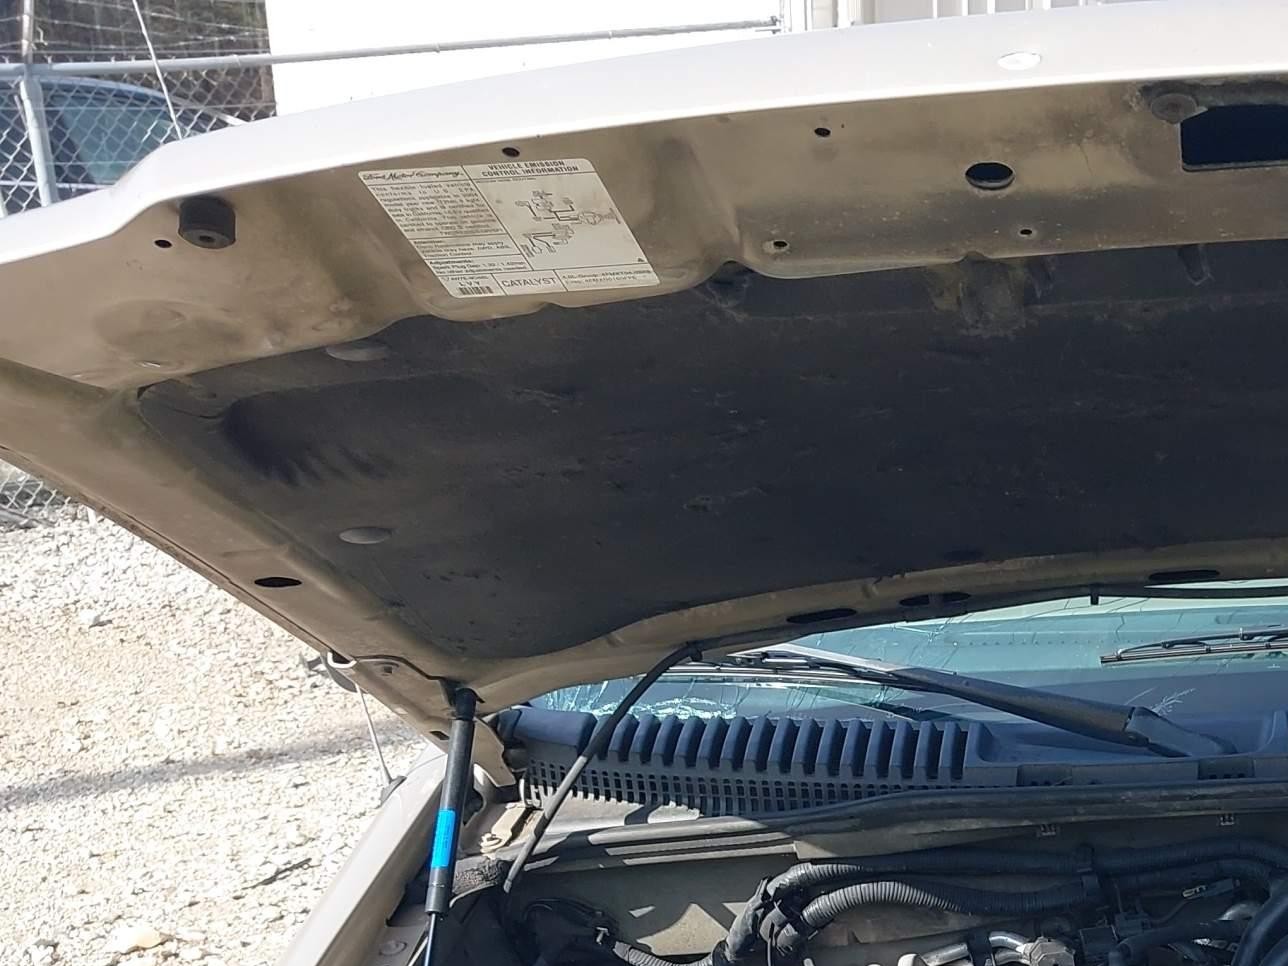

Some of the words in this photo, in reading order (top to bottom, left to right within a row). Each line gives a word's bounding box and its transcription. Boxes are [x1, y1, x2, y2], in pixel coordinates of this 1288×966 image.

[488, 162, 523, 170] VEHICLE
[524, 160, 565, 168] EMISSION
[482, 169, 520, 177] CONTROL
[522, 166, 579, 174] INFORMATION
[501, 277, 557, 288] CATALYST
